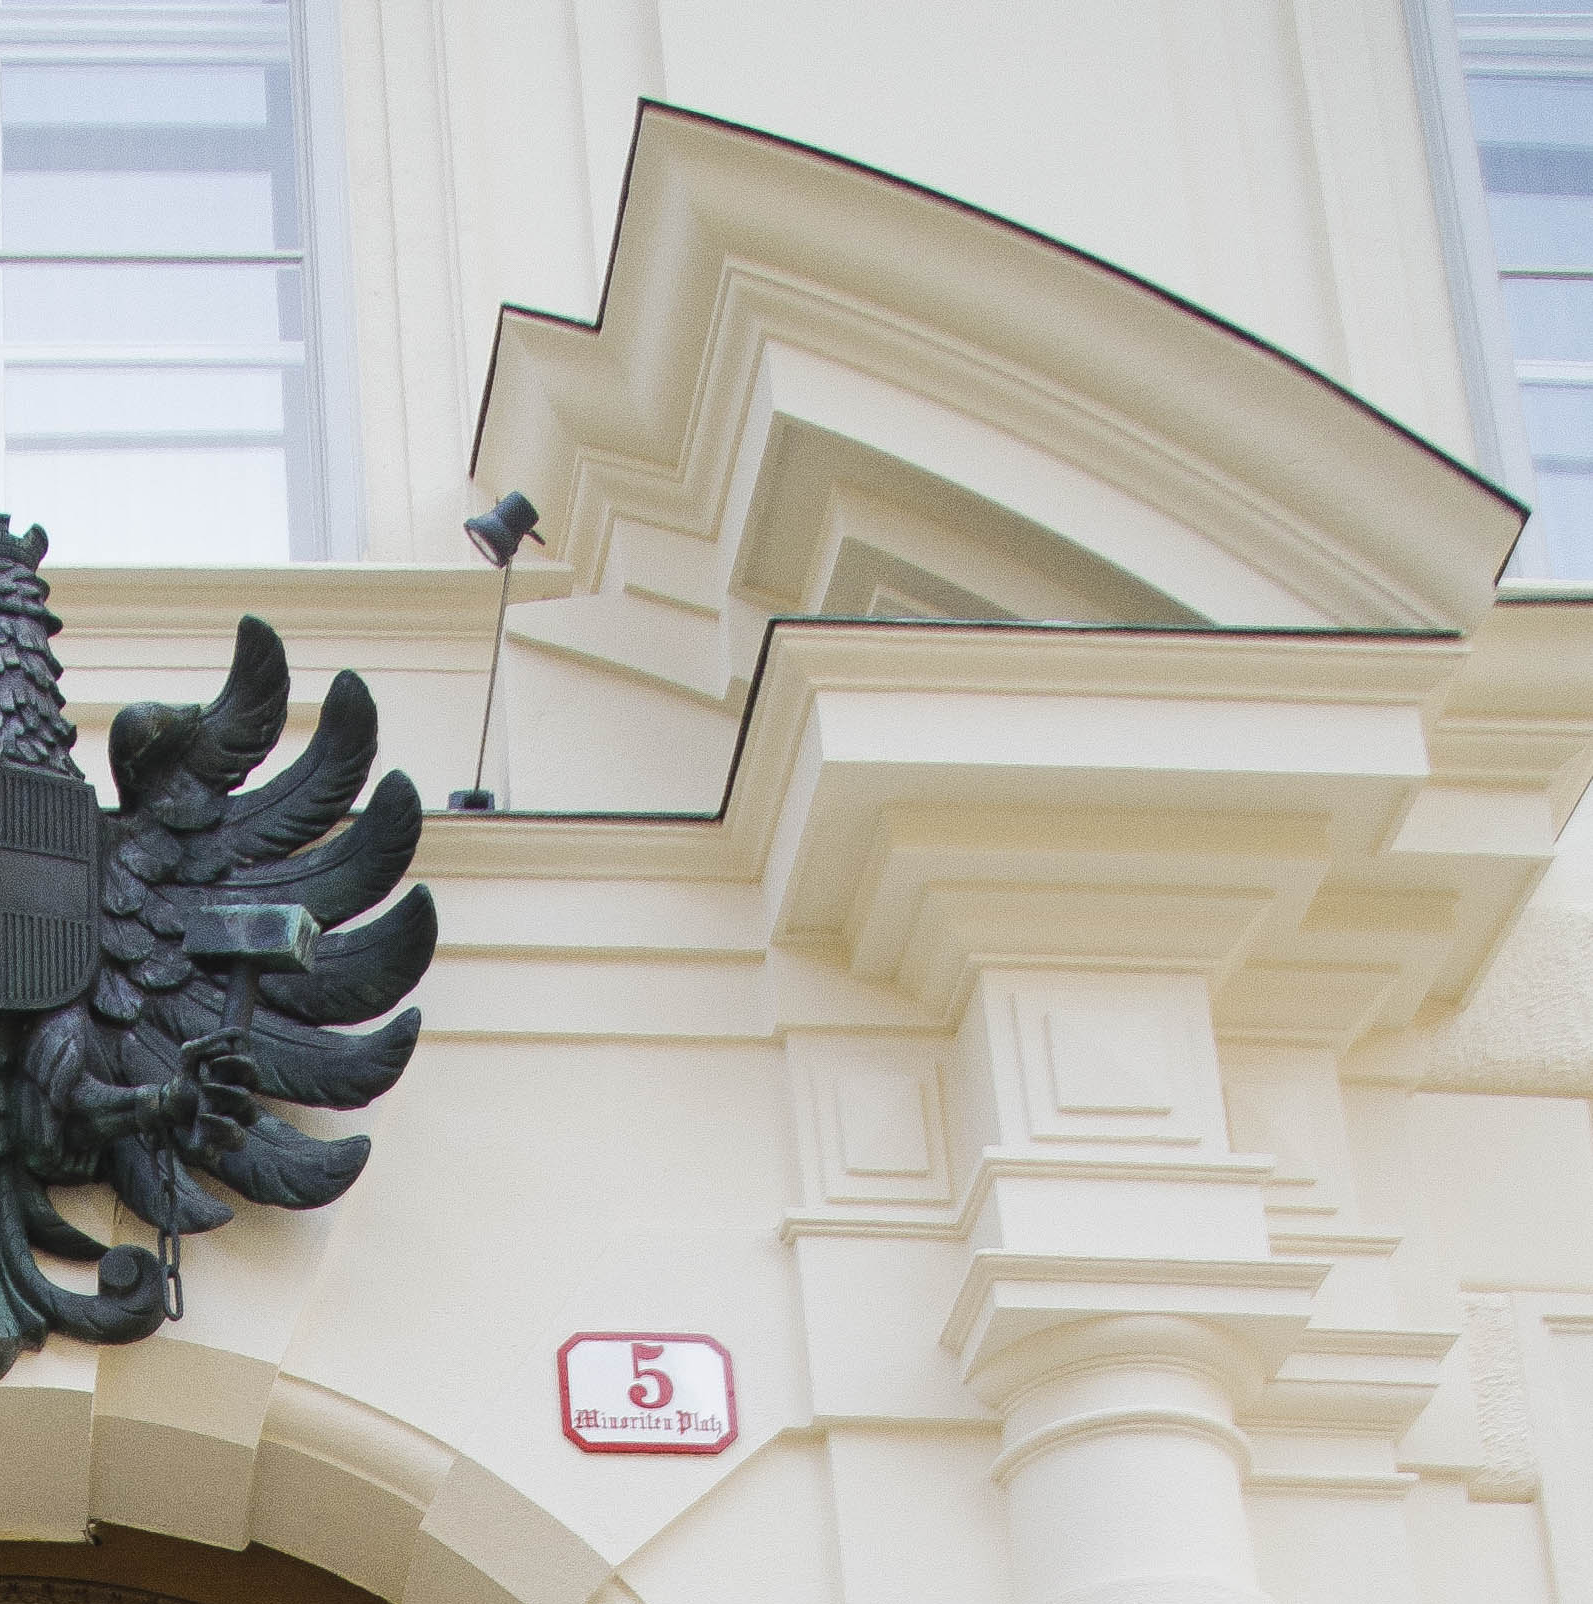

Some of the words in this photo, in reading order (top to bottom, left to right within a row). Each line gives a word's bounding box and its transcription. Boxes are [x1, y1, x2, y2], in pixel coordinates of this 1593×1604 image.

[627, 1342, 674, 1409] 5
[573, 1409, 672, 1431] Minoriten
[677, 1410, 722, 1437] Platz
